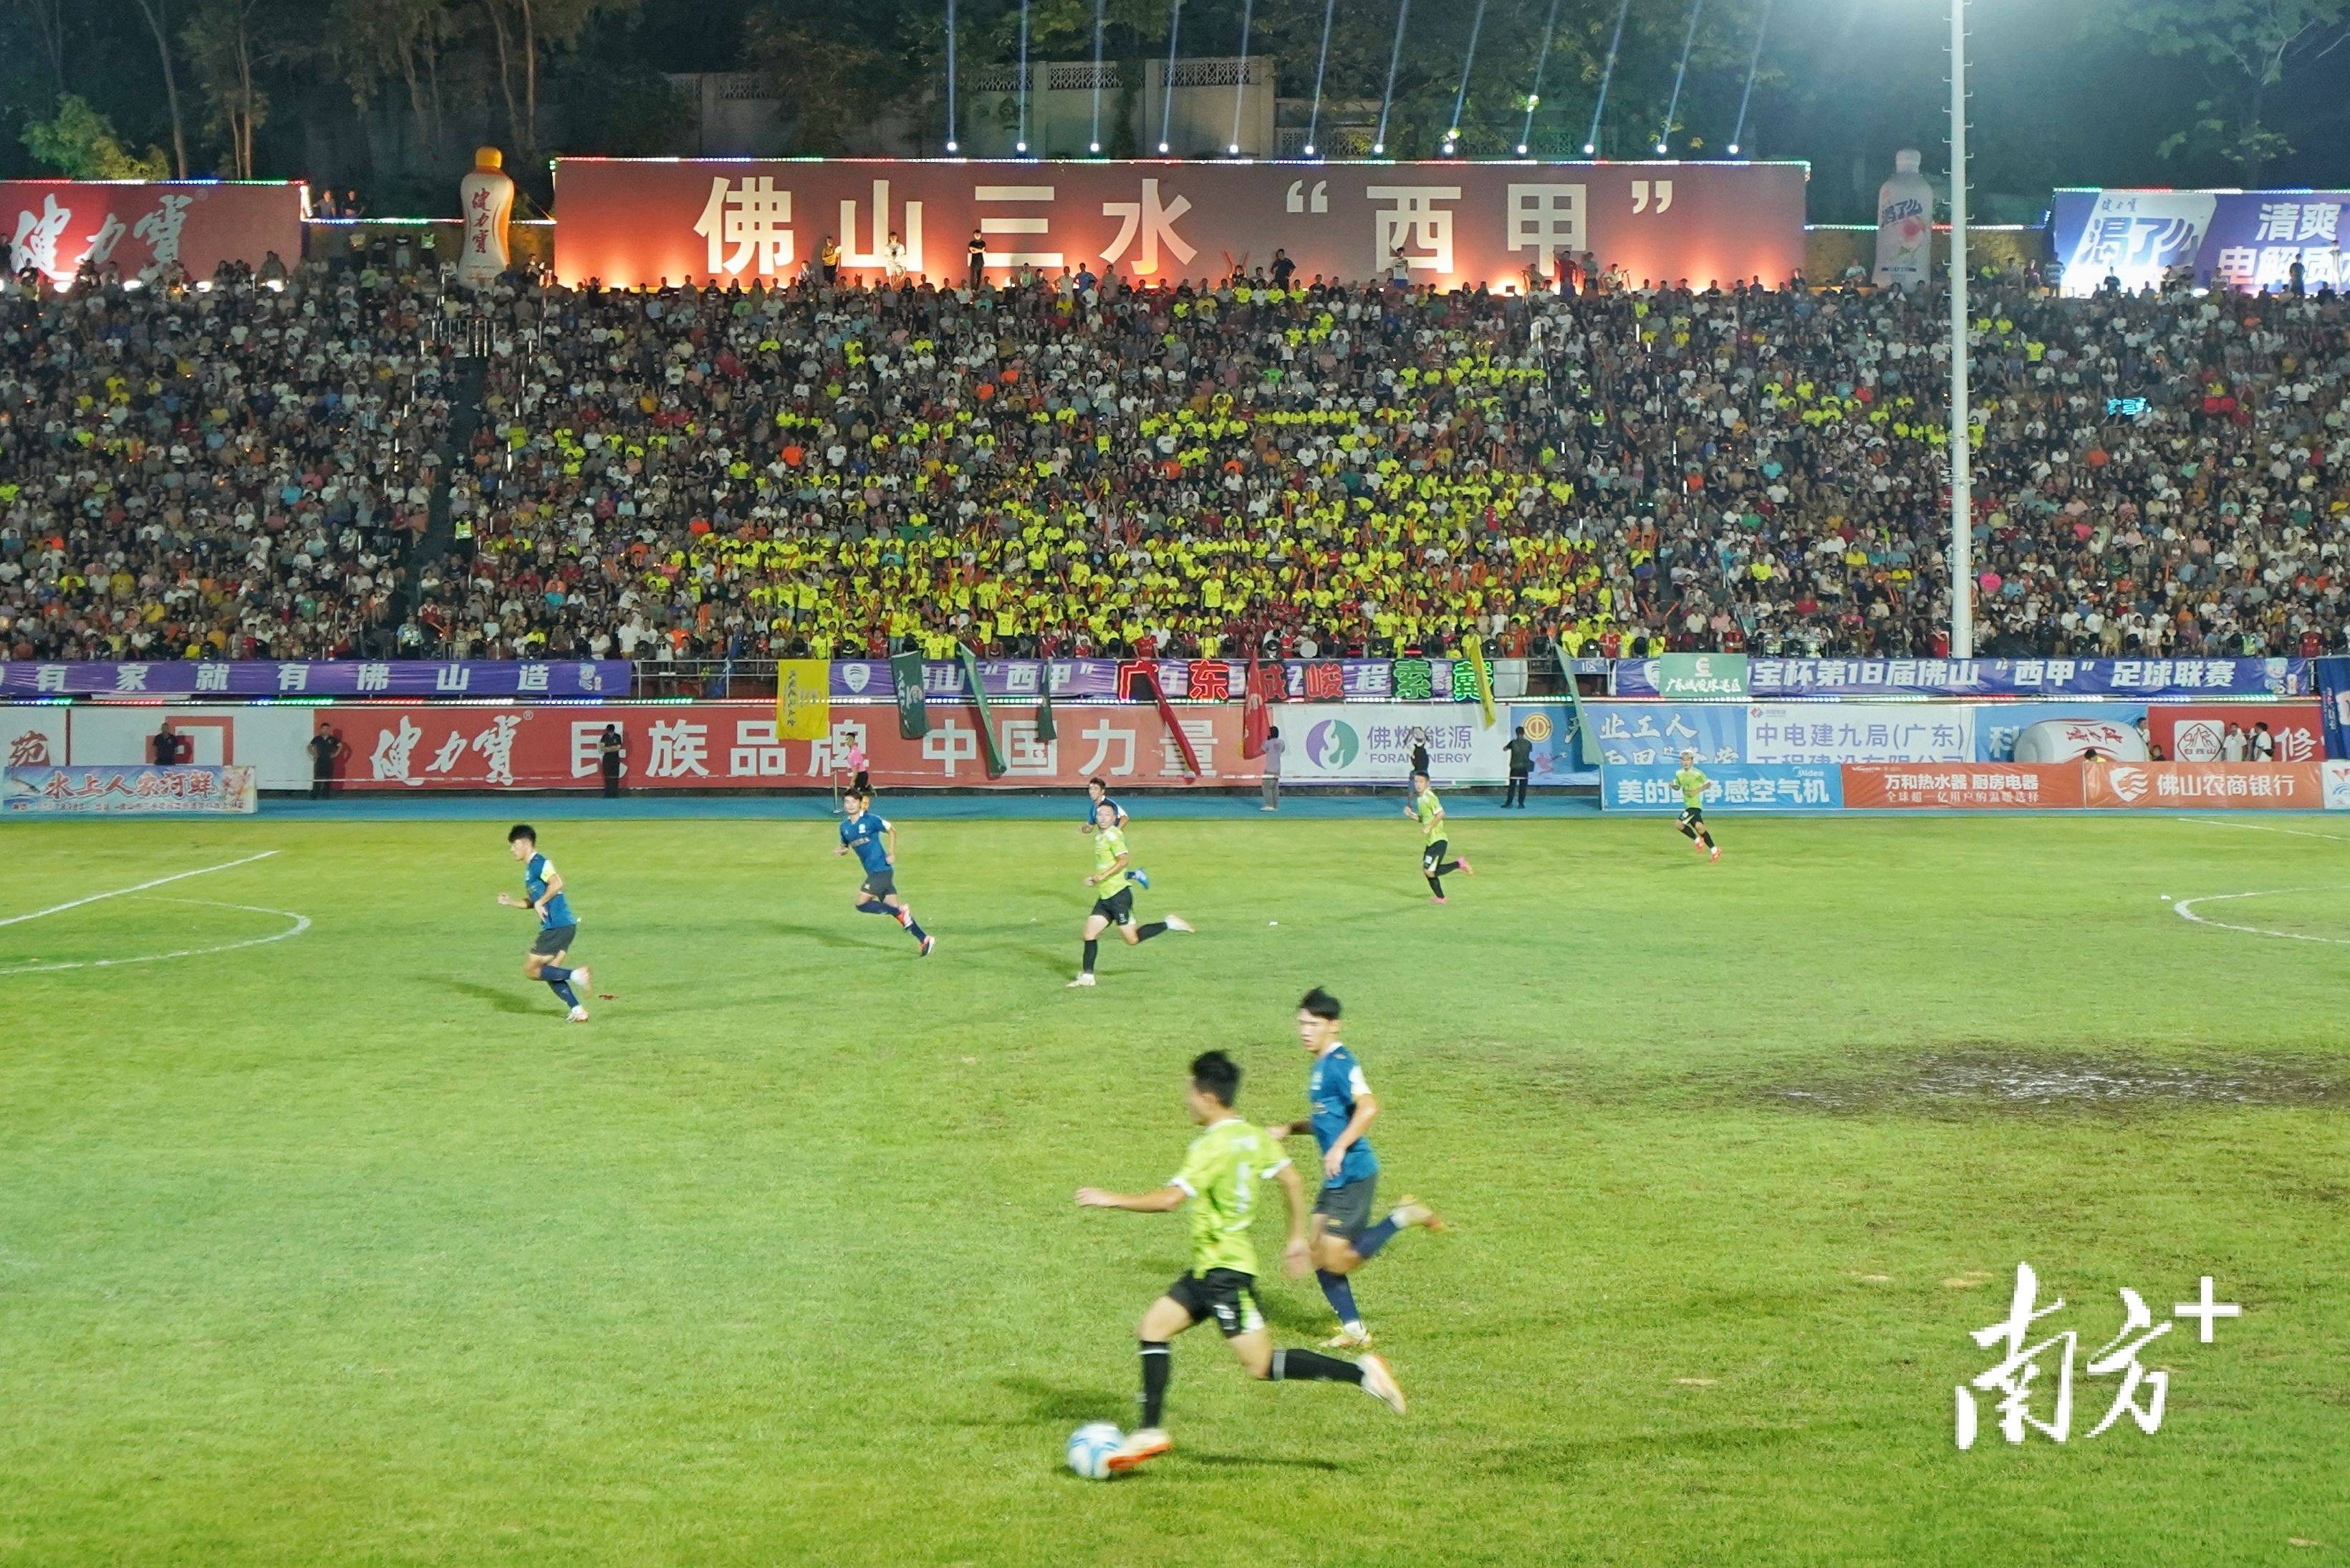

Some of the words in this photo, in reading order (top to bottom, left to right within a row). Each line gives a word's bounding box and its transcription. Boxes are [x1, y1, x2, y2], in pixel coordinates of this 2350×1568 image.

[693, 176, 1672, 277] 佛山三水“西甲”
[2255, 203, 2341, 241] 清爽
[2218, 246, 2350, 285] 电解质
[1747, 660, 2236, 688] 宝杯第18届佛山“西甲”足球联赛
[571, 718, 870, 779] 民族品牌
[922, 718, 1218, 779] 中国力量
[1425, 754, 1473, 764] NERGY
[1617, 779, 1829, 804] 美的净感空气机
[1884, 774, 1968, 790] 万和热水器
[1972, 774, 2039, 791] 厨房电器
[2156, 774, 2296, 797] 佛山农商银行
